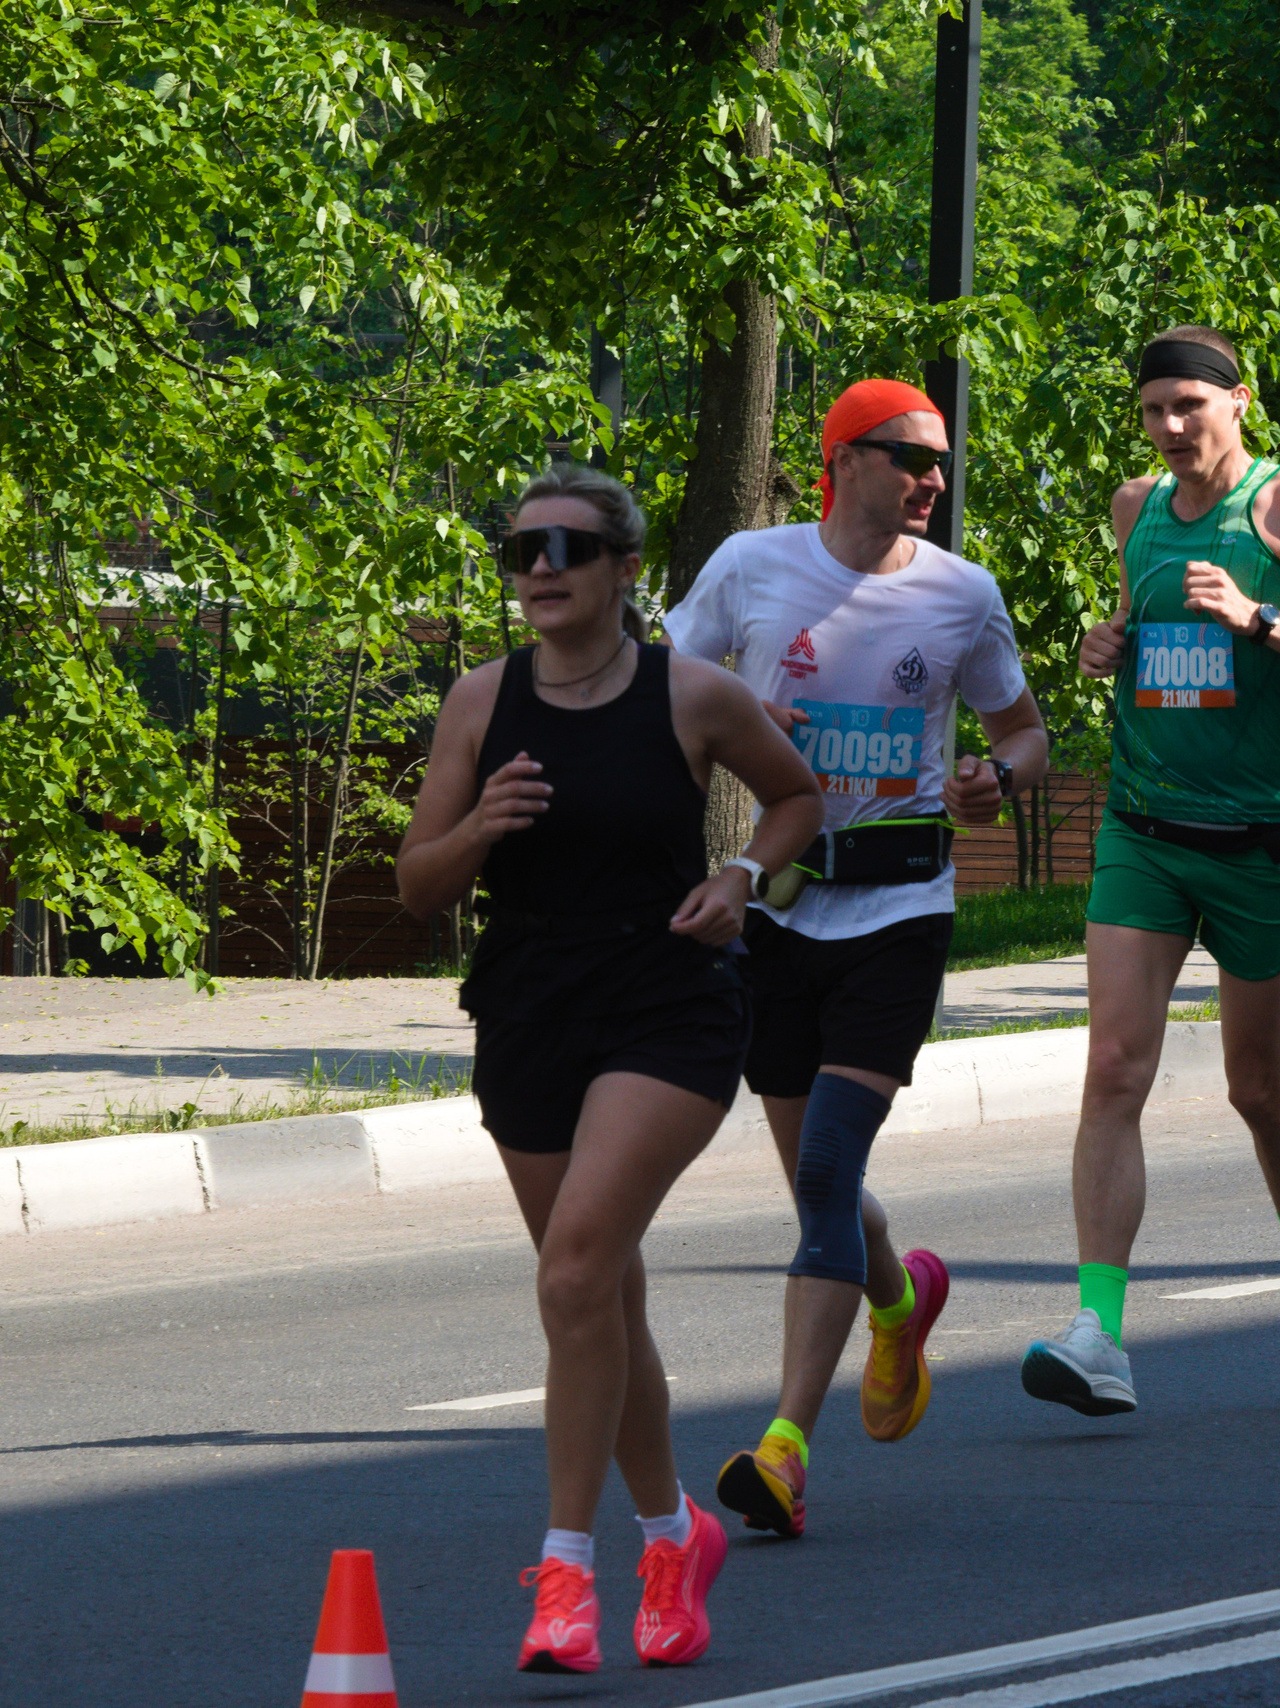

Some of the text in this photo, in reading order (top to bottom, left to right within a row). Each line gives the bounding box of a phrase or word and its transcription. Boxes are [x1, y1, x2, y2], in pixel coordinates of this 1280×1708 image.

[1143, 647, 1227, 686] 70008
[1161, 689, 1200, 708] 21.1KM
[799, 727, 912, 774] 70093
[827, 775, 877, 796] 21.1KM
